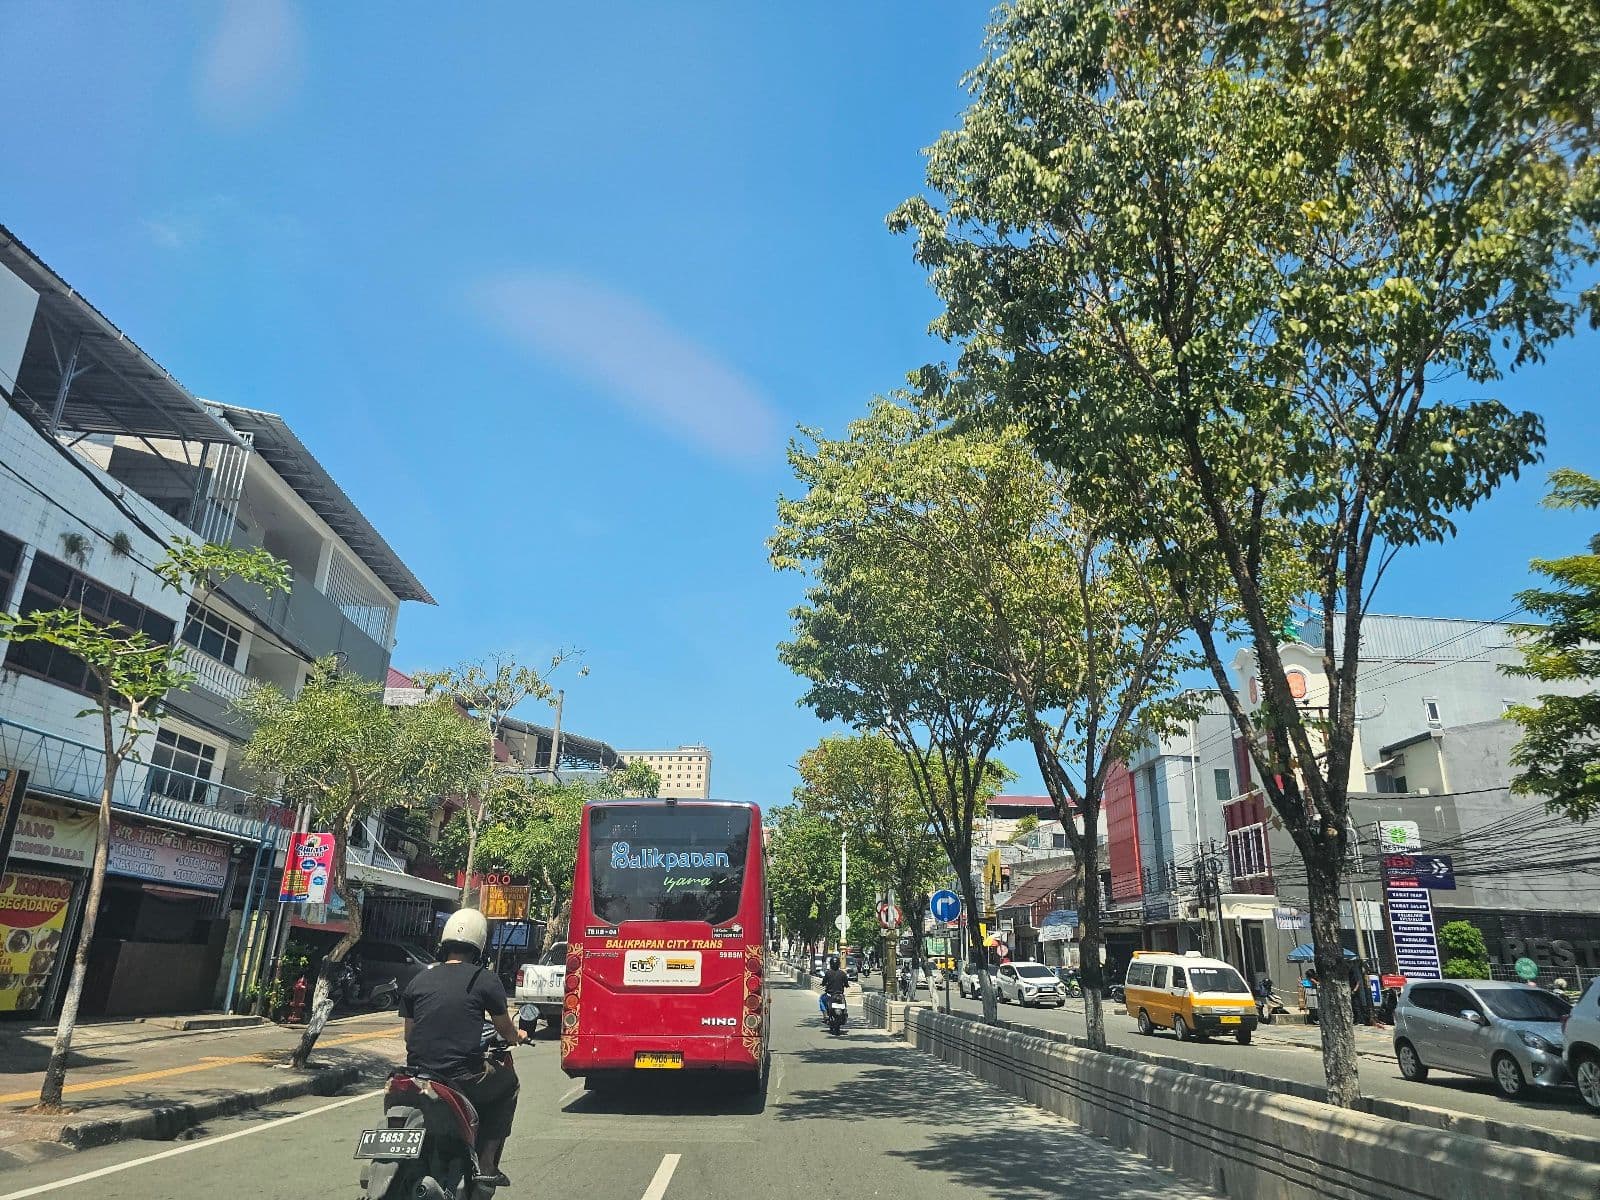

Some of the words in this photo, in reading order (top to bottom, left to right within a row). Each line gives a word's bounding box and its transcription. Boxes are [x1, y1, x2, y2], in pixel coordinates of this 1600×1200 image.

[139, 847, 156, 860] TEK
[176, 868, 196, 881] SOTO
[0, 898, 58, 913] BEGADANG
[605, 940, 665, 949] BALIKPAPAN
[666, 940, 688, 949] CITY
[691, 940, 723, 949] TRANS
[701, 1017, 737, 1026] HINO
[363, 1133, 377, 1144] KT
[406, 1132, 421, 1143] ZS
